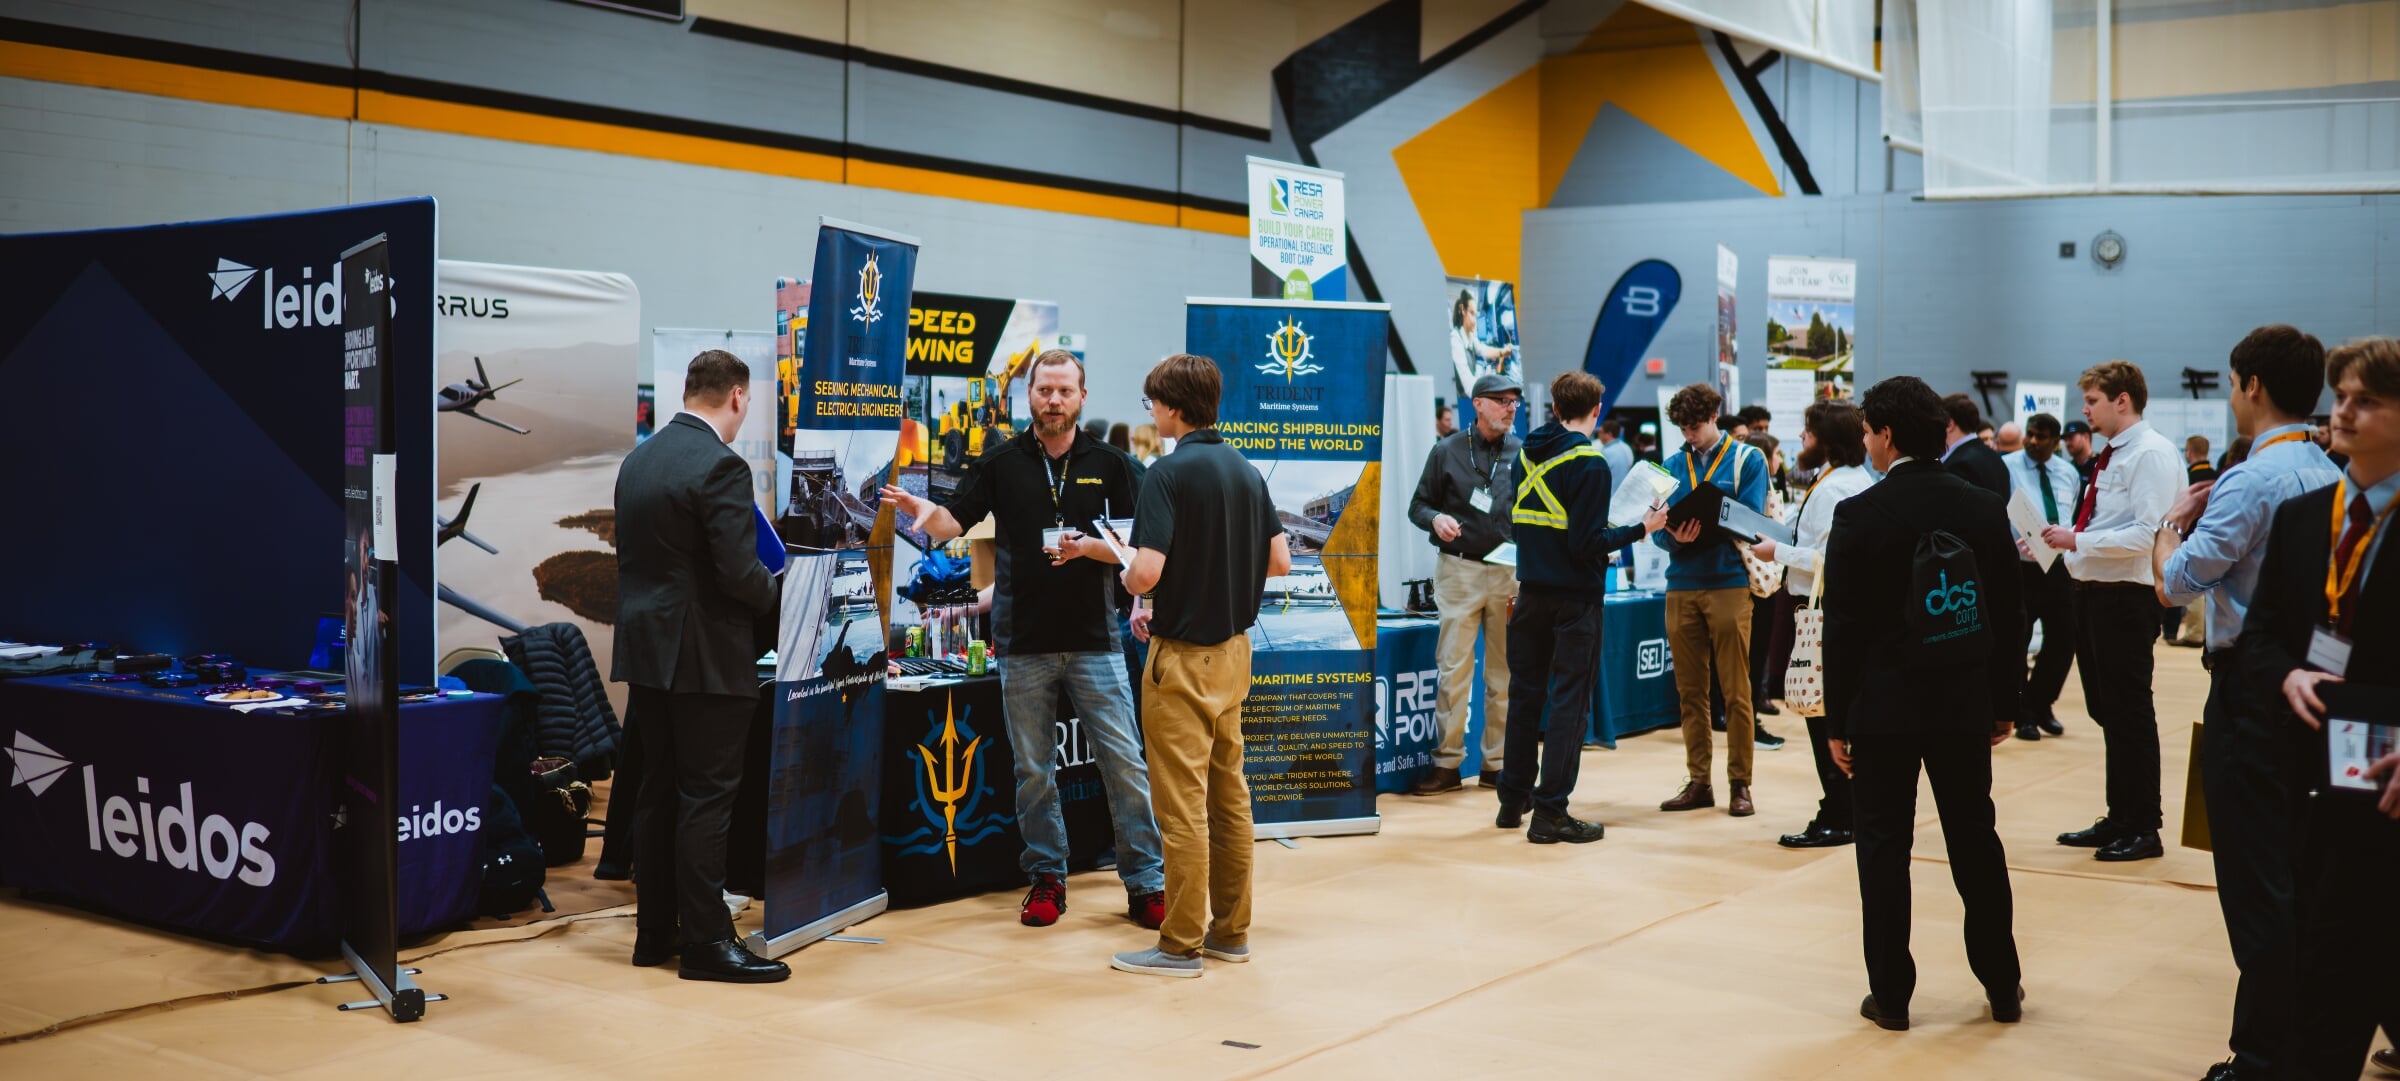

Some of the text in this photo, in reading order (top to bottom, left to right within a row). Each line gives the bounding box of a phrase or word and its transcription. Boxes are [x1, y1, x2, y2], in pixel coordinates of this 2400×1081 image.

[1294, 180, 1323, 198] RESA
[1294, 196, 1323, 208] POWER
[1294, 207, 1324, 220] CANADA
[1258, 219, 1335, 242] BUILD YOUR CAREER
[1259, 235, 1333, 256] OPERATIONAL EXCELLENCE
[1280, 251, 1314, 266] BOOT CAMP
[263, 260, 397, 330] leid
[908, 308, 976, 335] PEED
[906, 337, 974, 364] WING
[815, 380, 849, 397] SEEKING
[850, 382, 898, 399] MECHANICAL
[1254, 385, 1325, 401] TRIDENT
[816, 401, 903, 417] ELECTRICAL ENGINEERS
[1259, 402, 1319, 412] Maritime Systems
[1212, 421, 1381, 436] VANCING SHIPBUILDING
[1223, 437, 1364, 451] ROUND THE WORLD
[1925, 568, 1978, 616] dcs
[1956, 606, 1978, 625] corp
[1640, 647, 1661, 671] SEL
[1251, 672, 1372, 685] MARITIME SYSTEMS
[1249, 694, 1287, 702] COMPANY
[1288, 693, 1306, 701] THAT
[1252, 704, 1292, 713] SPECTRUM
[1305, 703, 1341, 711] MARITIME
[1241, 714, 1329, 724] FRASTRUCTURE NEEDS.
[1276, 733, 1289, 741] WE
[1290, 732, 1321, 740] DELIVER
[1322, 731, 1369, 739] UNMATCHED
[1249, 744, 1276, 753] VALUE,
[1277, 742, 1309, 752] QUALITY,
[1310, 742, 1327, 750] AND
[1328, 741, 1353, 749] SPEED
[1354, 741, 1365, 749] TO
[1264, 754, 1298, 763] AROUND
[1298, 753, 1313, 761] THE
[1314, 753, 1345, 761] WORLD.
[1383, 757, 1395, 773] and
[1398, 754, 1416, 771] Safe.
[1417, 751, 1429, 767] The
[1251, 773, 1268, 781] YOU
[1286, 771, 1318, 779] TRIDENT
[1254, 783, 1307, 792] WORLD-CLASS
[1255, 793, 1305, 803] WORLDWIDE.
[82, 764, 276, 888] leidos
[398, 800, 481, 842] eidos
